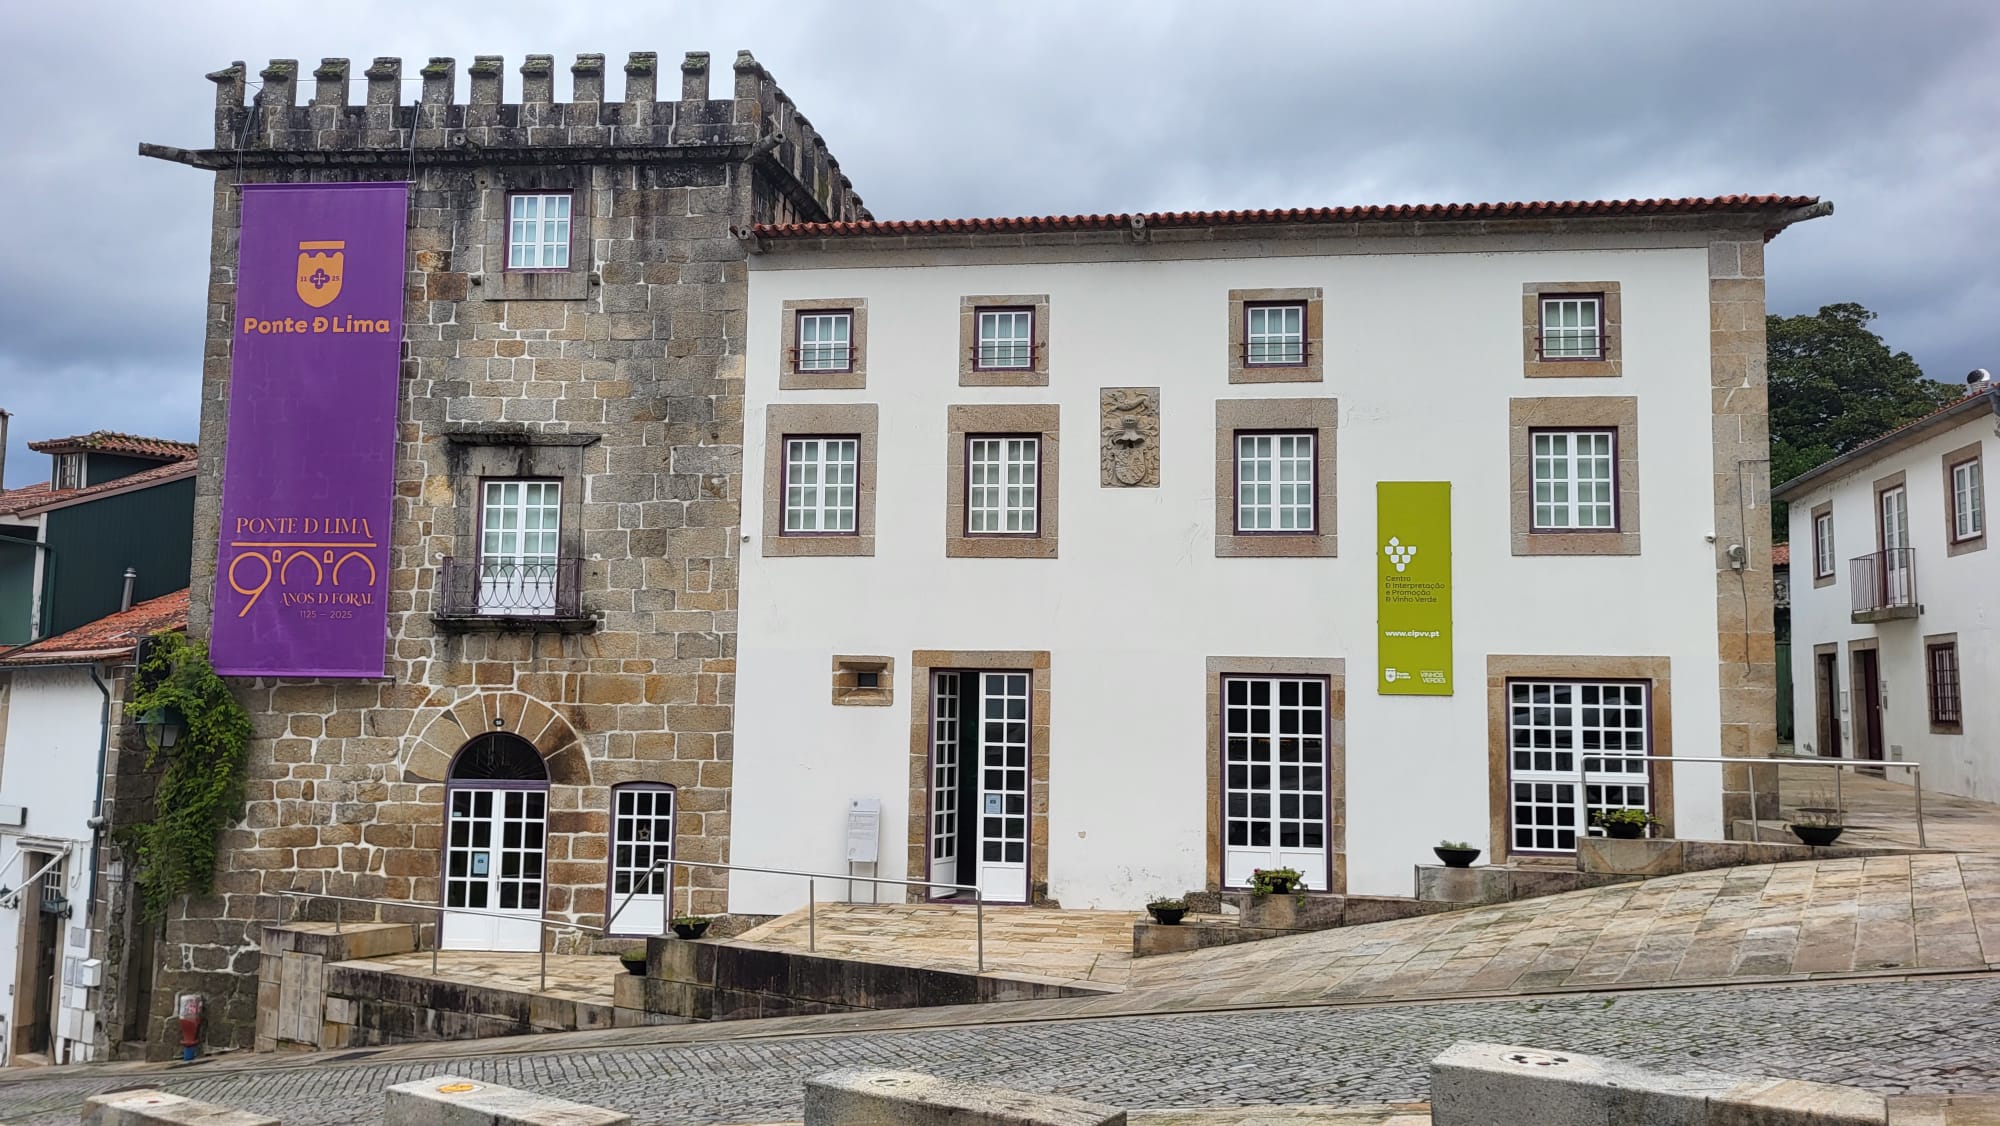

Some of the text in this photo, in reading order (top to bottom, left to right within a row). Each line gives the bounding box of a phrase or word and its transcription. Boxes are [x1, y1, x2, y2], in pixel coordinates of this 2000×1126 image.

[243, 316, 308, 334] Ponte
[332, 315, 390, 333] Lima
[236, 517, 374, 538] PONTE D LIMA
[1392, 582, 1446, 590] Interpretação
[1392, 589, 1431, 597] Promoção
[280, 592, 374, 607] ANOS D FORAL
[300, 610, 317, 619] 1125
[330, 610, 353, 619] 2025
[1384, 629, 1440, 639] www.cipvv.pt
